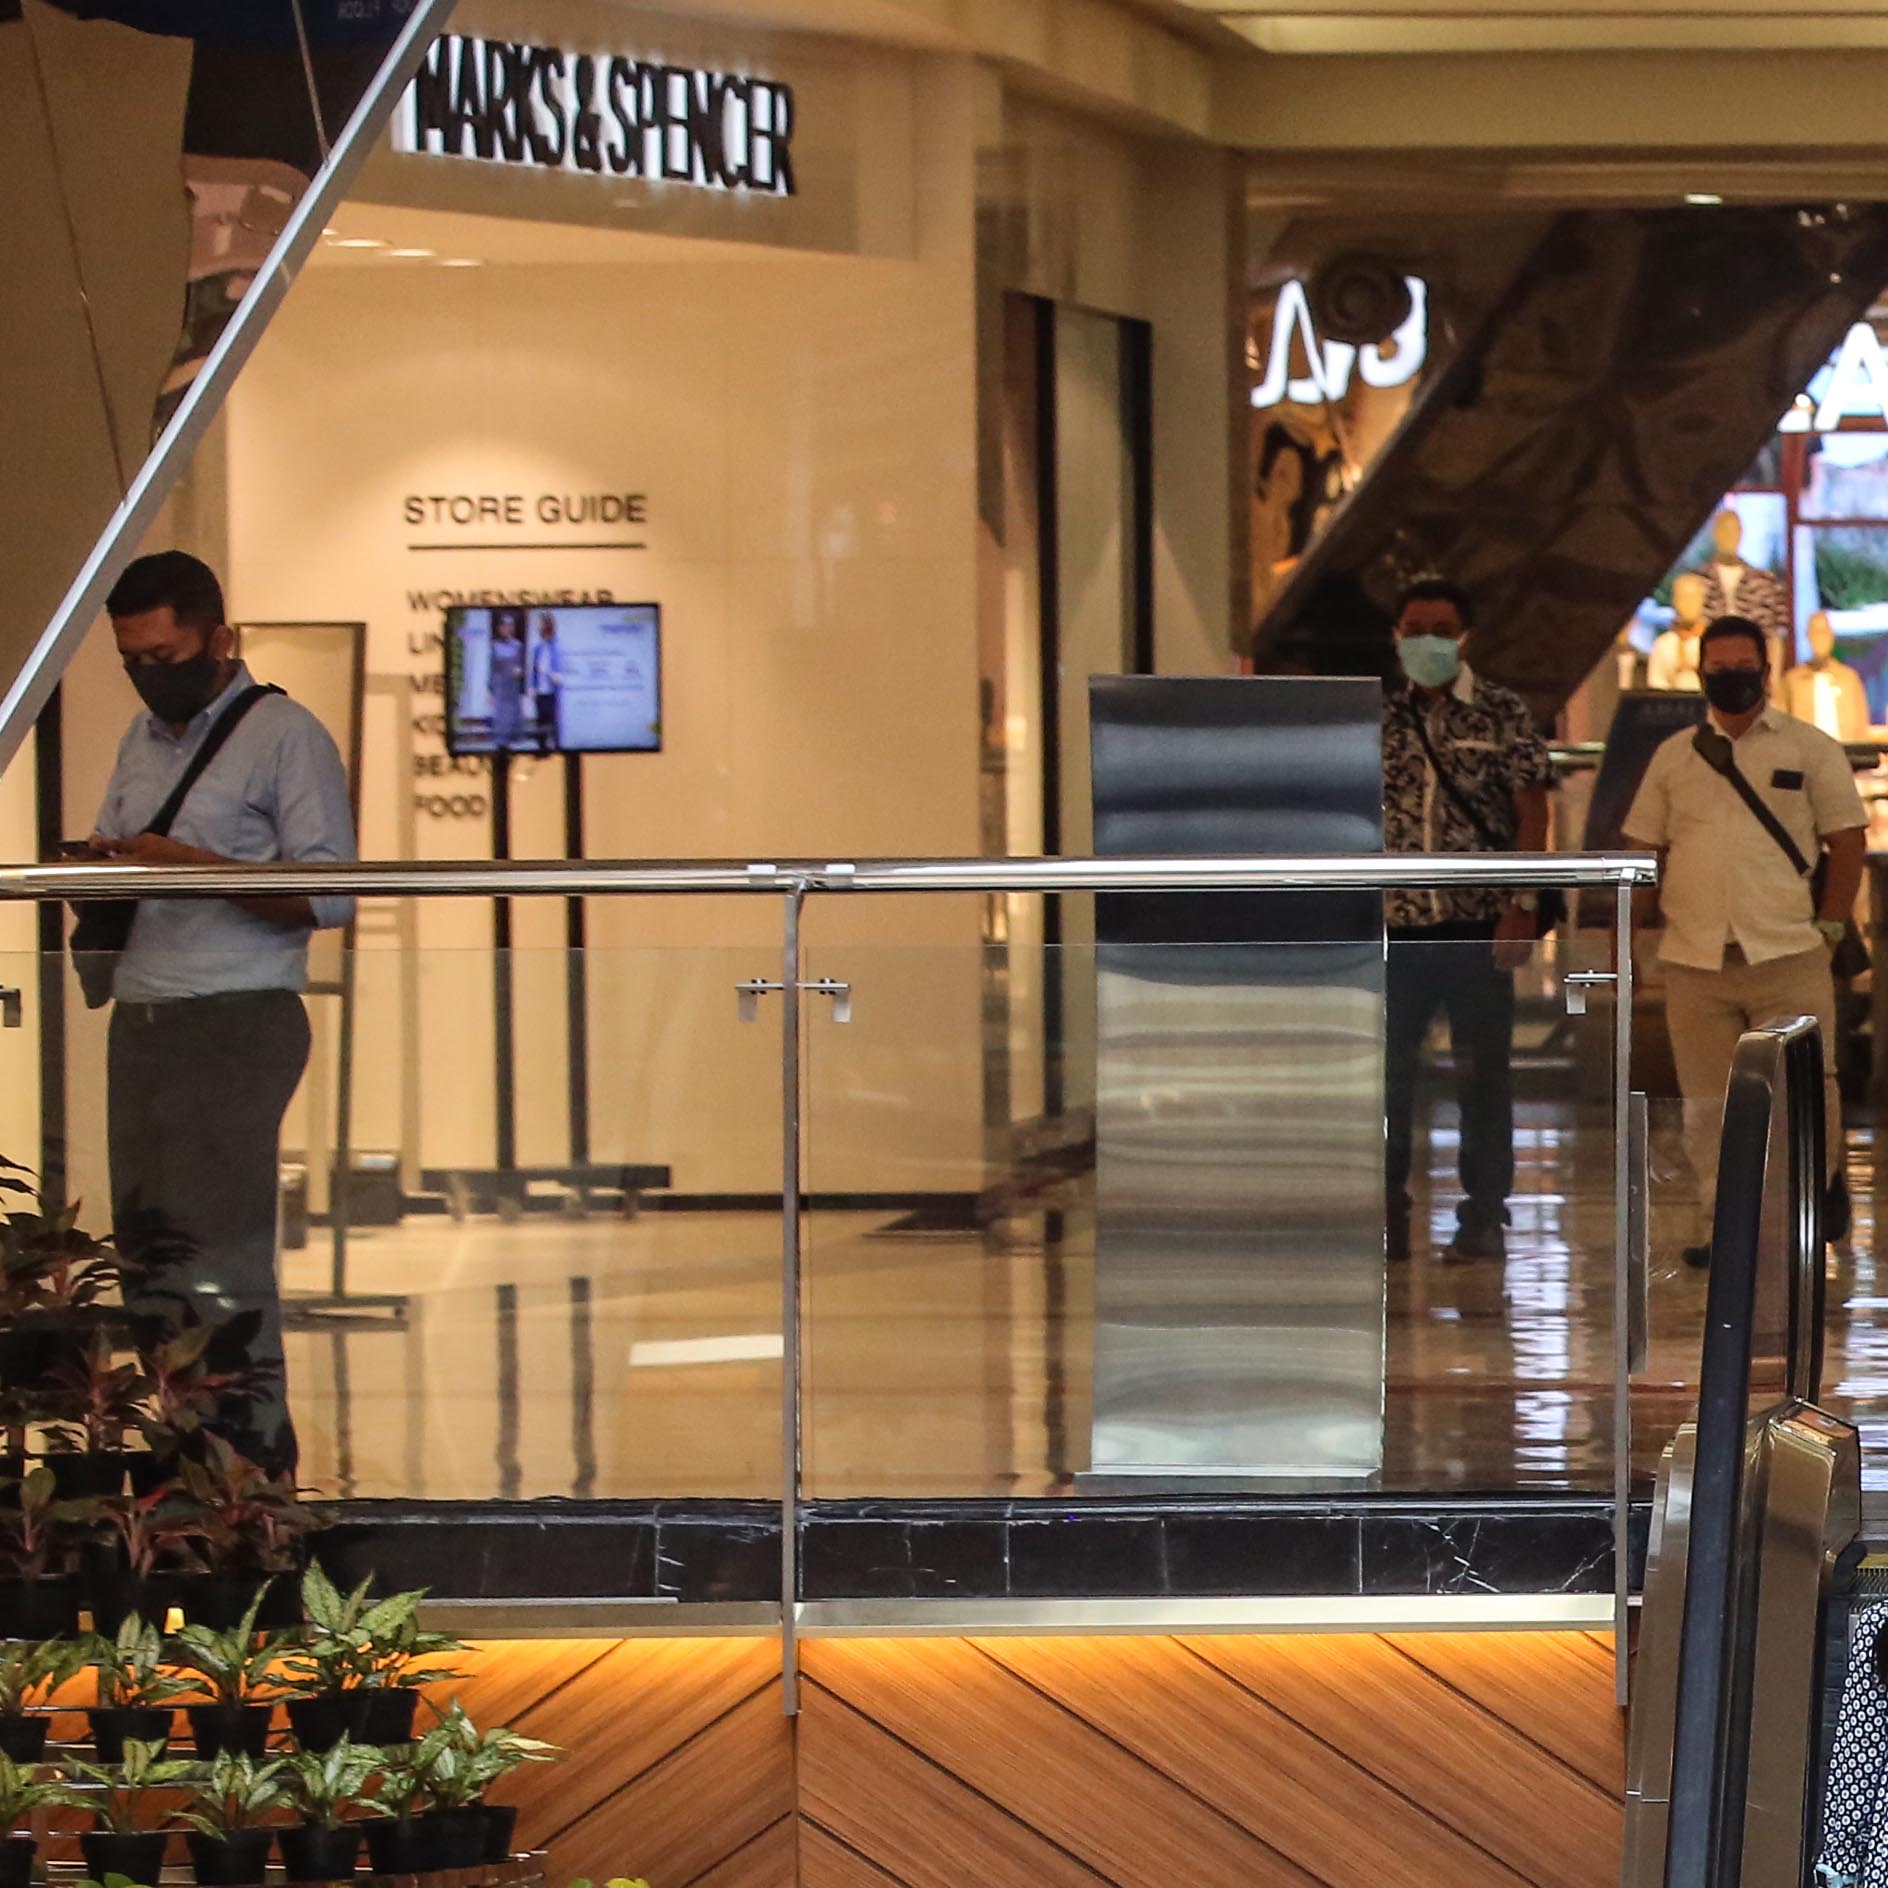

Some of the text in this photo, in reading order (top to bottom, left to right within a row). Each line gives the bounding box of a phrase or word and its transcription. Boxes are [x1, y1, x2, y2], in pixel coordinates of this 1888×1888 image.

[410, 34, 795, 195] MARKS & SPENCER
[404, 494, 648, 525] STORE GUIDE
